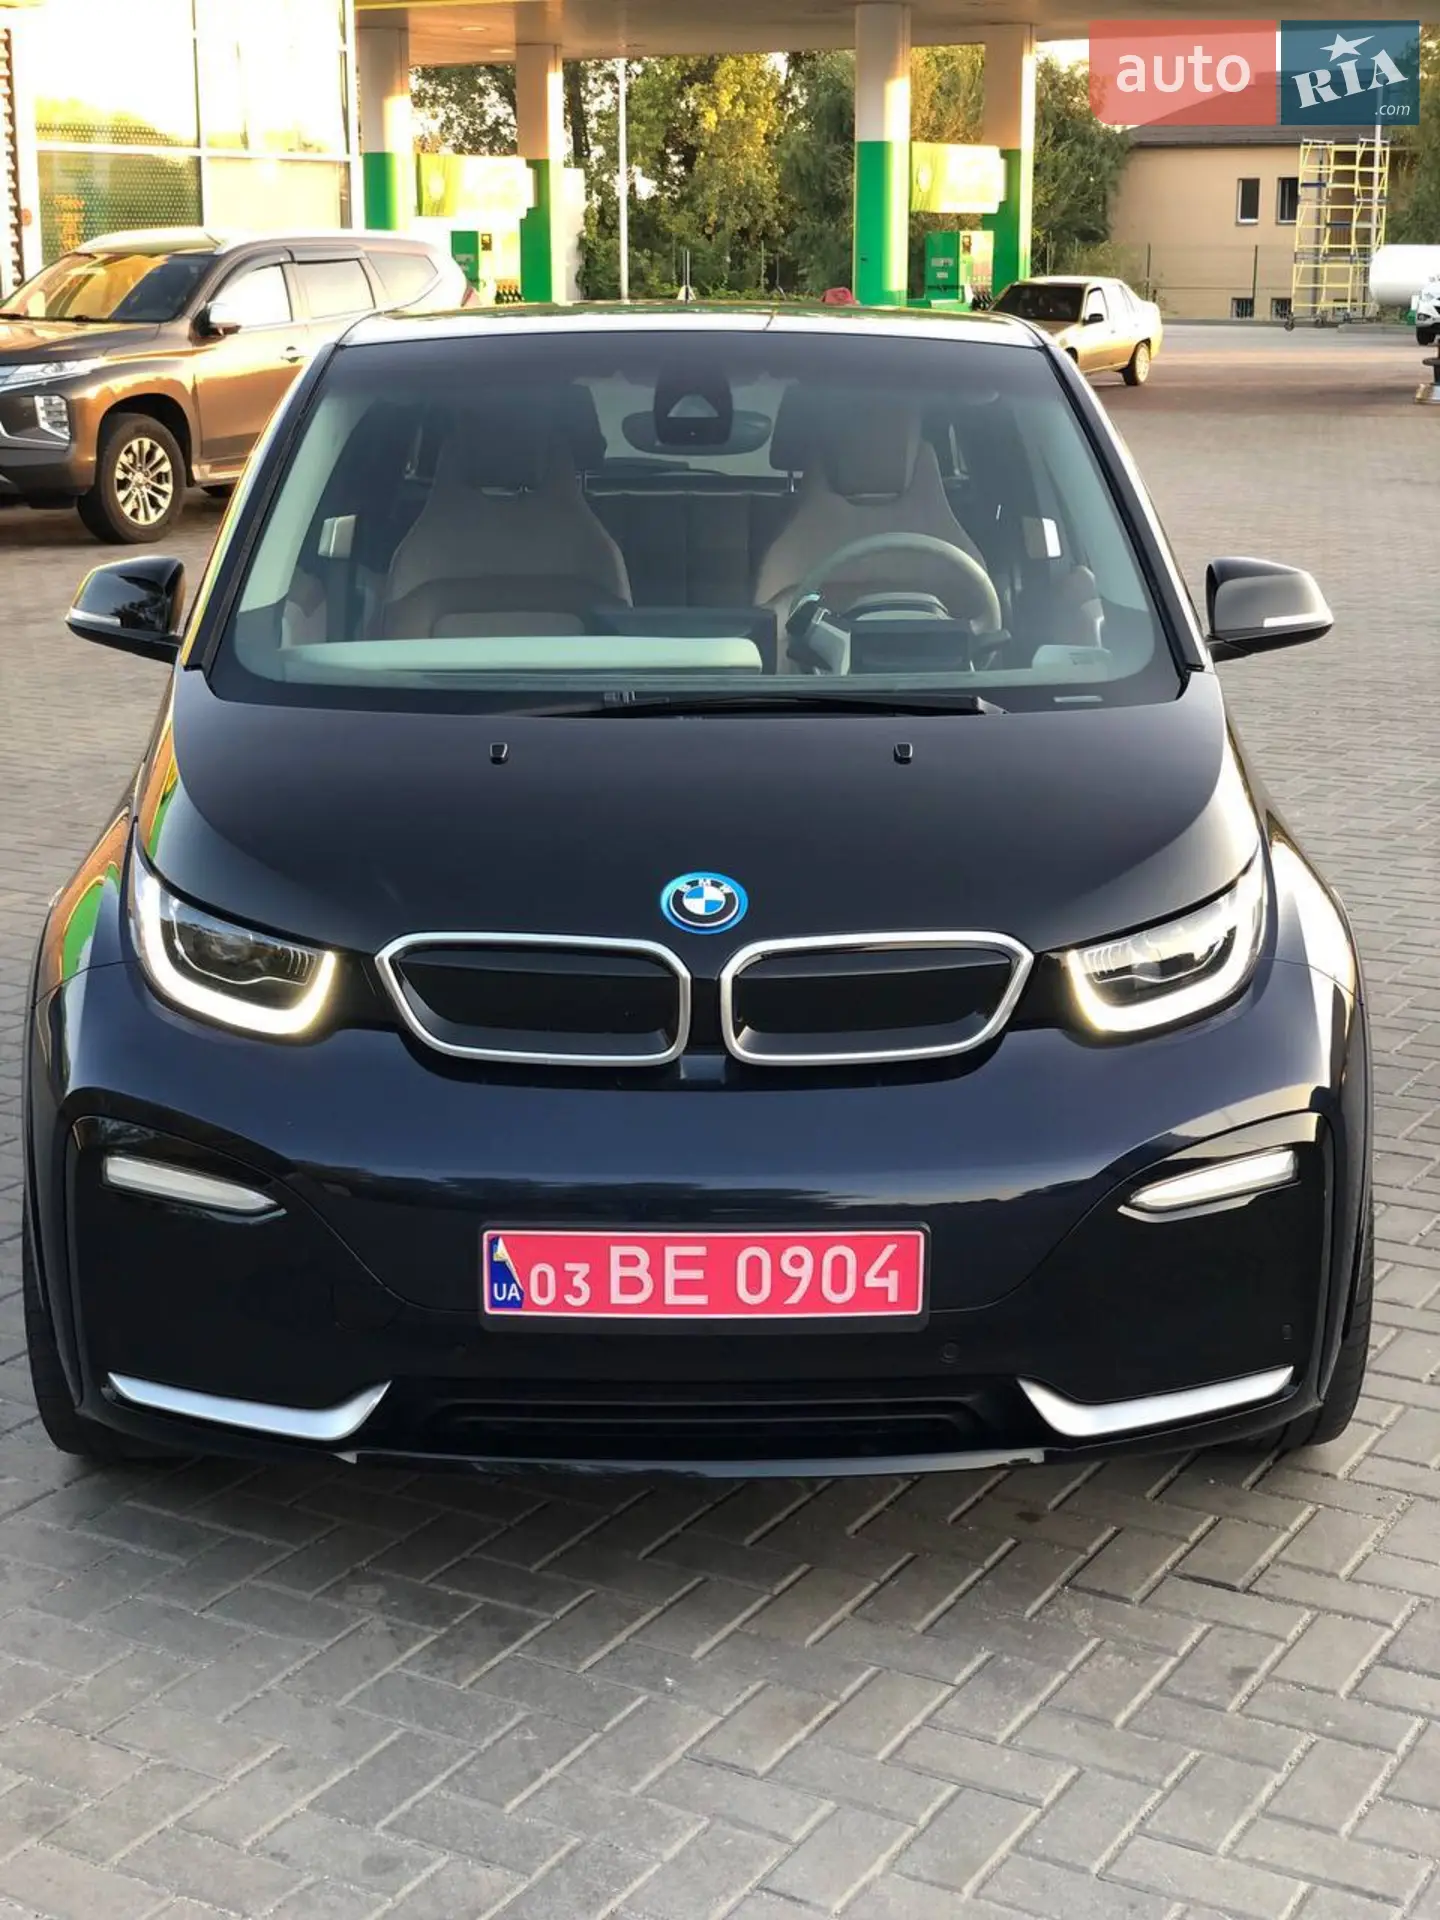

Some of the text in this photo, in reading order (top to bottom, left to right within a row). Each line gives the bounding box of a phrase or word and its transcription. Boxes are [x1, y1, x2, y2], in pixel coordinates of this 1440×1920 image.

[677, 878, 733, 893] BMW
[529, 1244, 899, 1307] 03 BE 0904
[493, 1283, 521, 1302] UA
